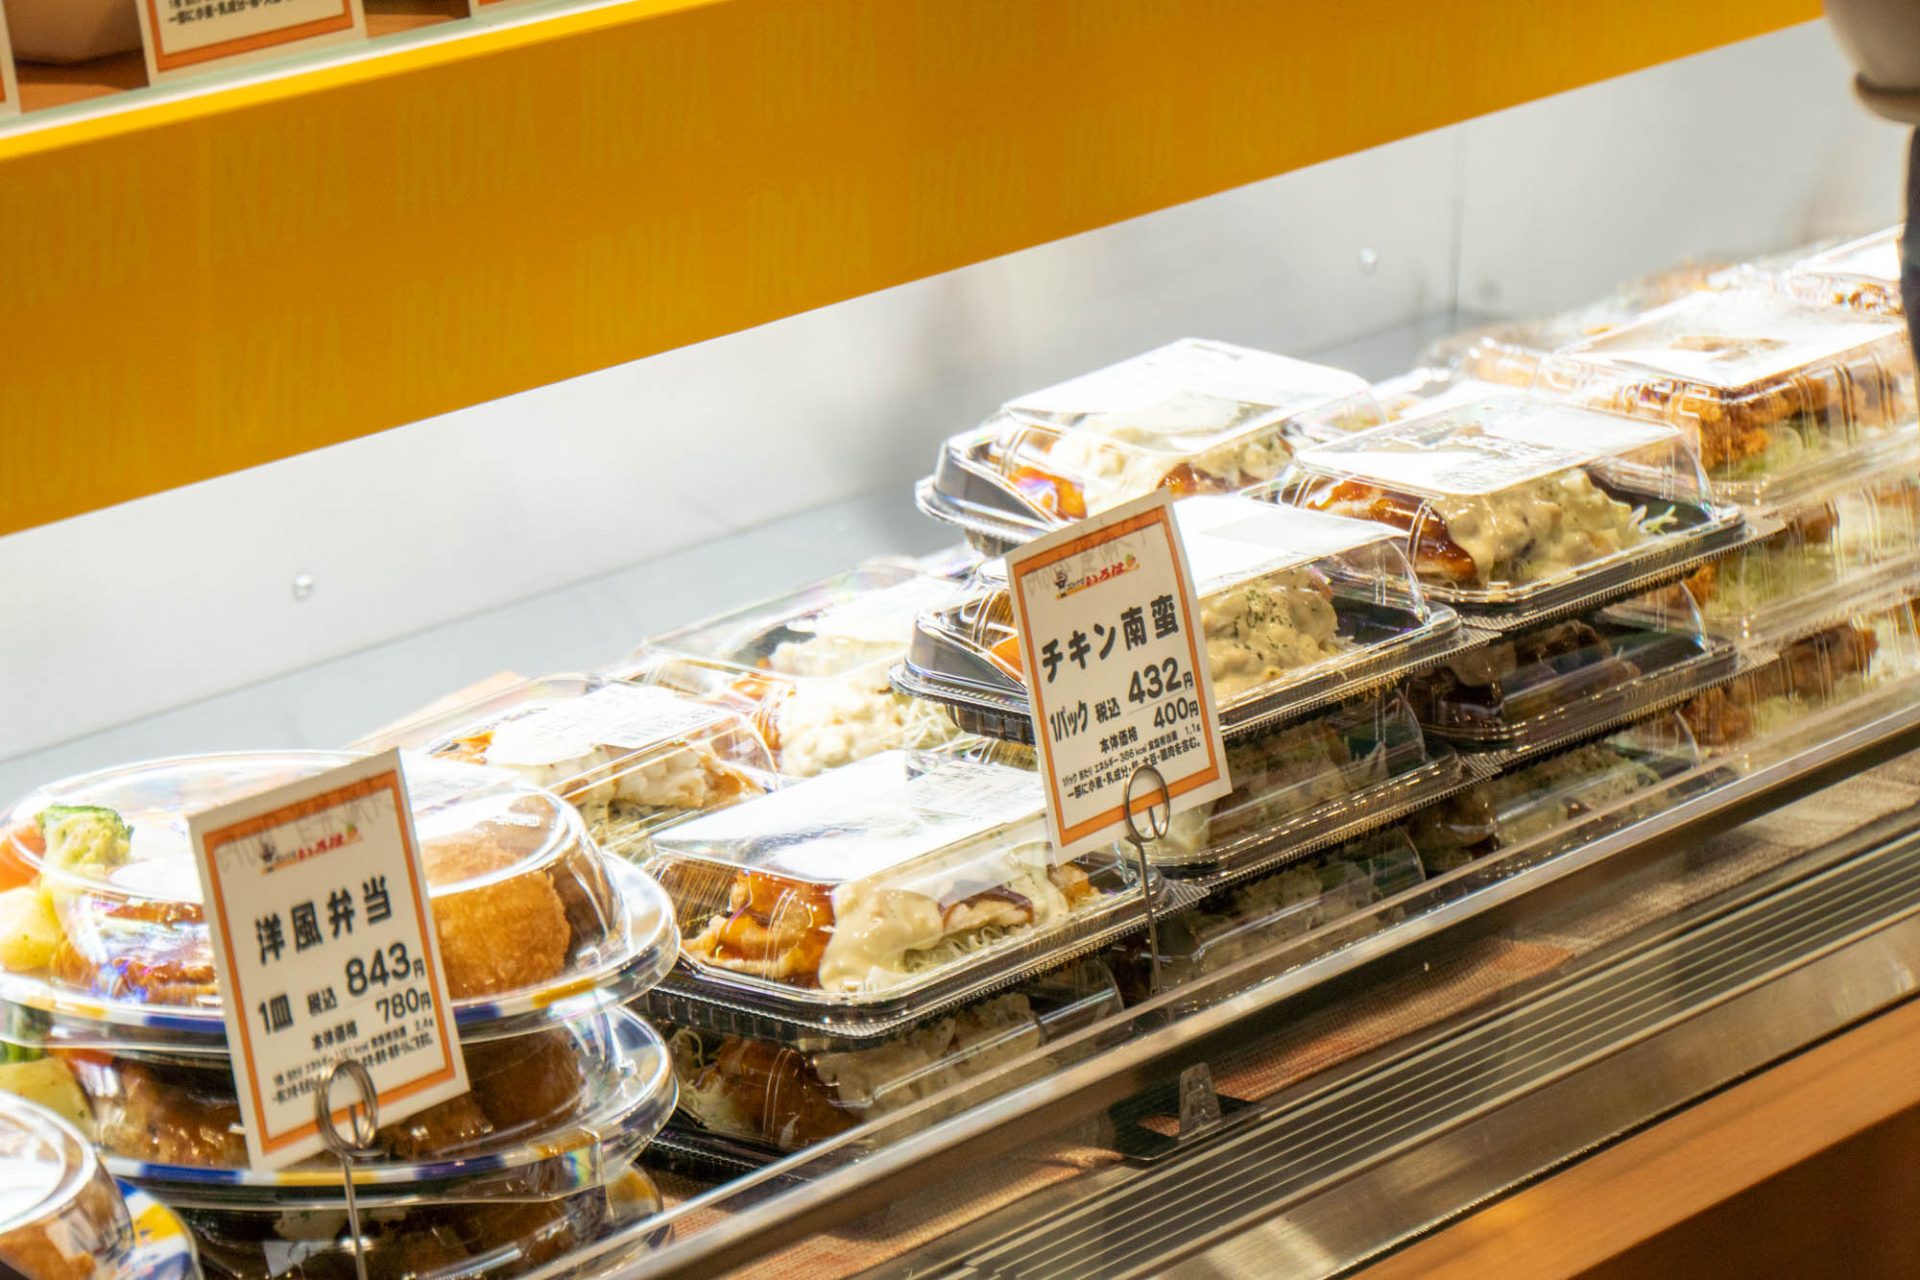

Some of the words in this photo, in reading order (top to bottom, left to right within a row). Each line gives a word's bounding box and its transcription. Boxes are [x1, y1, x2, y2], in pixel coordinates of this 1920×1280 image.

[1041, 594, 1180, 683] チキン南蛮
[1050, 700, 1089, 742] 1パック
[1094, 697, 1121, 724] 税込
[1128, 656, 1194, 706] 432円
[1100, 726, 1138, 755] 本体価格
[1153, 697, 1200, 730] 400円
[255, 874, 392, 967] 洋風弁当
[258, 993, 294, 1035] 1皿
[345, 942, 425, 998] 843円
[375, 987, 433, 1026] 780円
